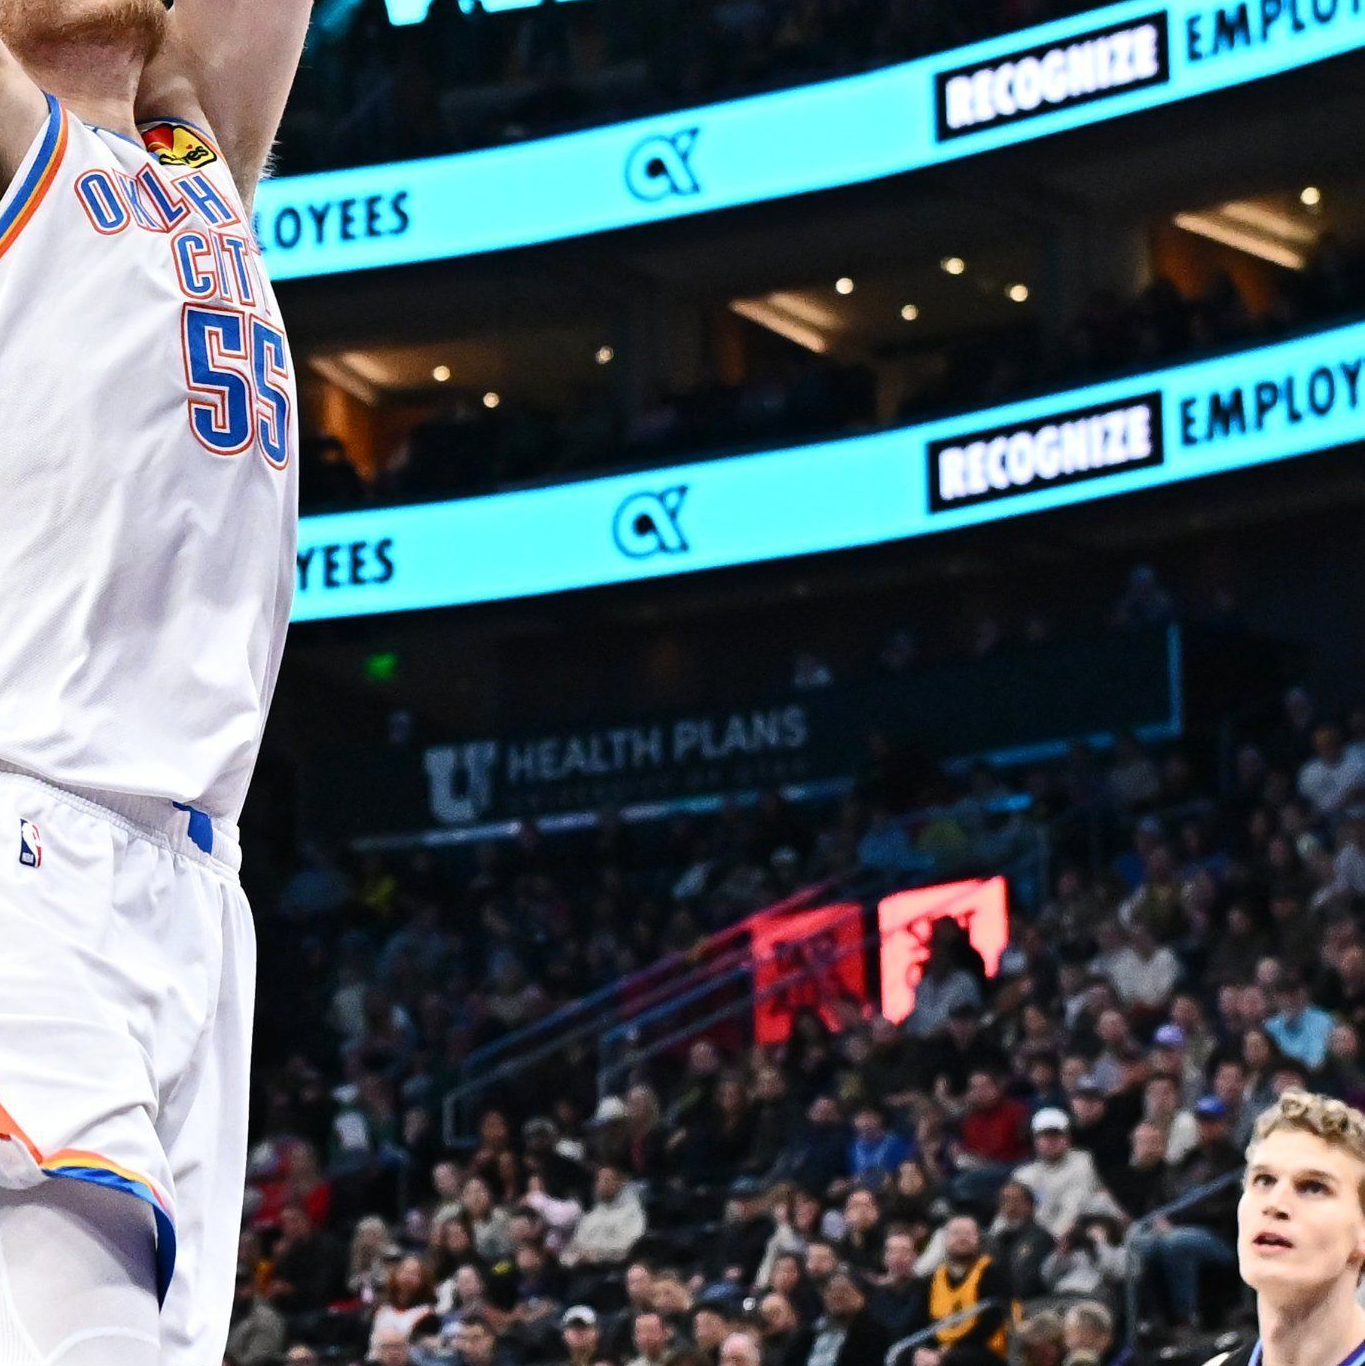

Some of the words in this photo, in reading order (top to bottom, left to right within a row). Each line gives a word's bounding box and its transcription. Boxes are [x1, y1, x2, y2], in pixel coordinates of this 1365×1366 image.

[944, 22, 1159, 130] RECOGNIZE
[257, 191, 410, 251] OYEES
[181, 301, 290, 470] 55
[938, 403, 1153, 501] RECOGNIZE
[507, 727, 663, 783] HEALTH
[673, 704, 808, 763] PLANS
